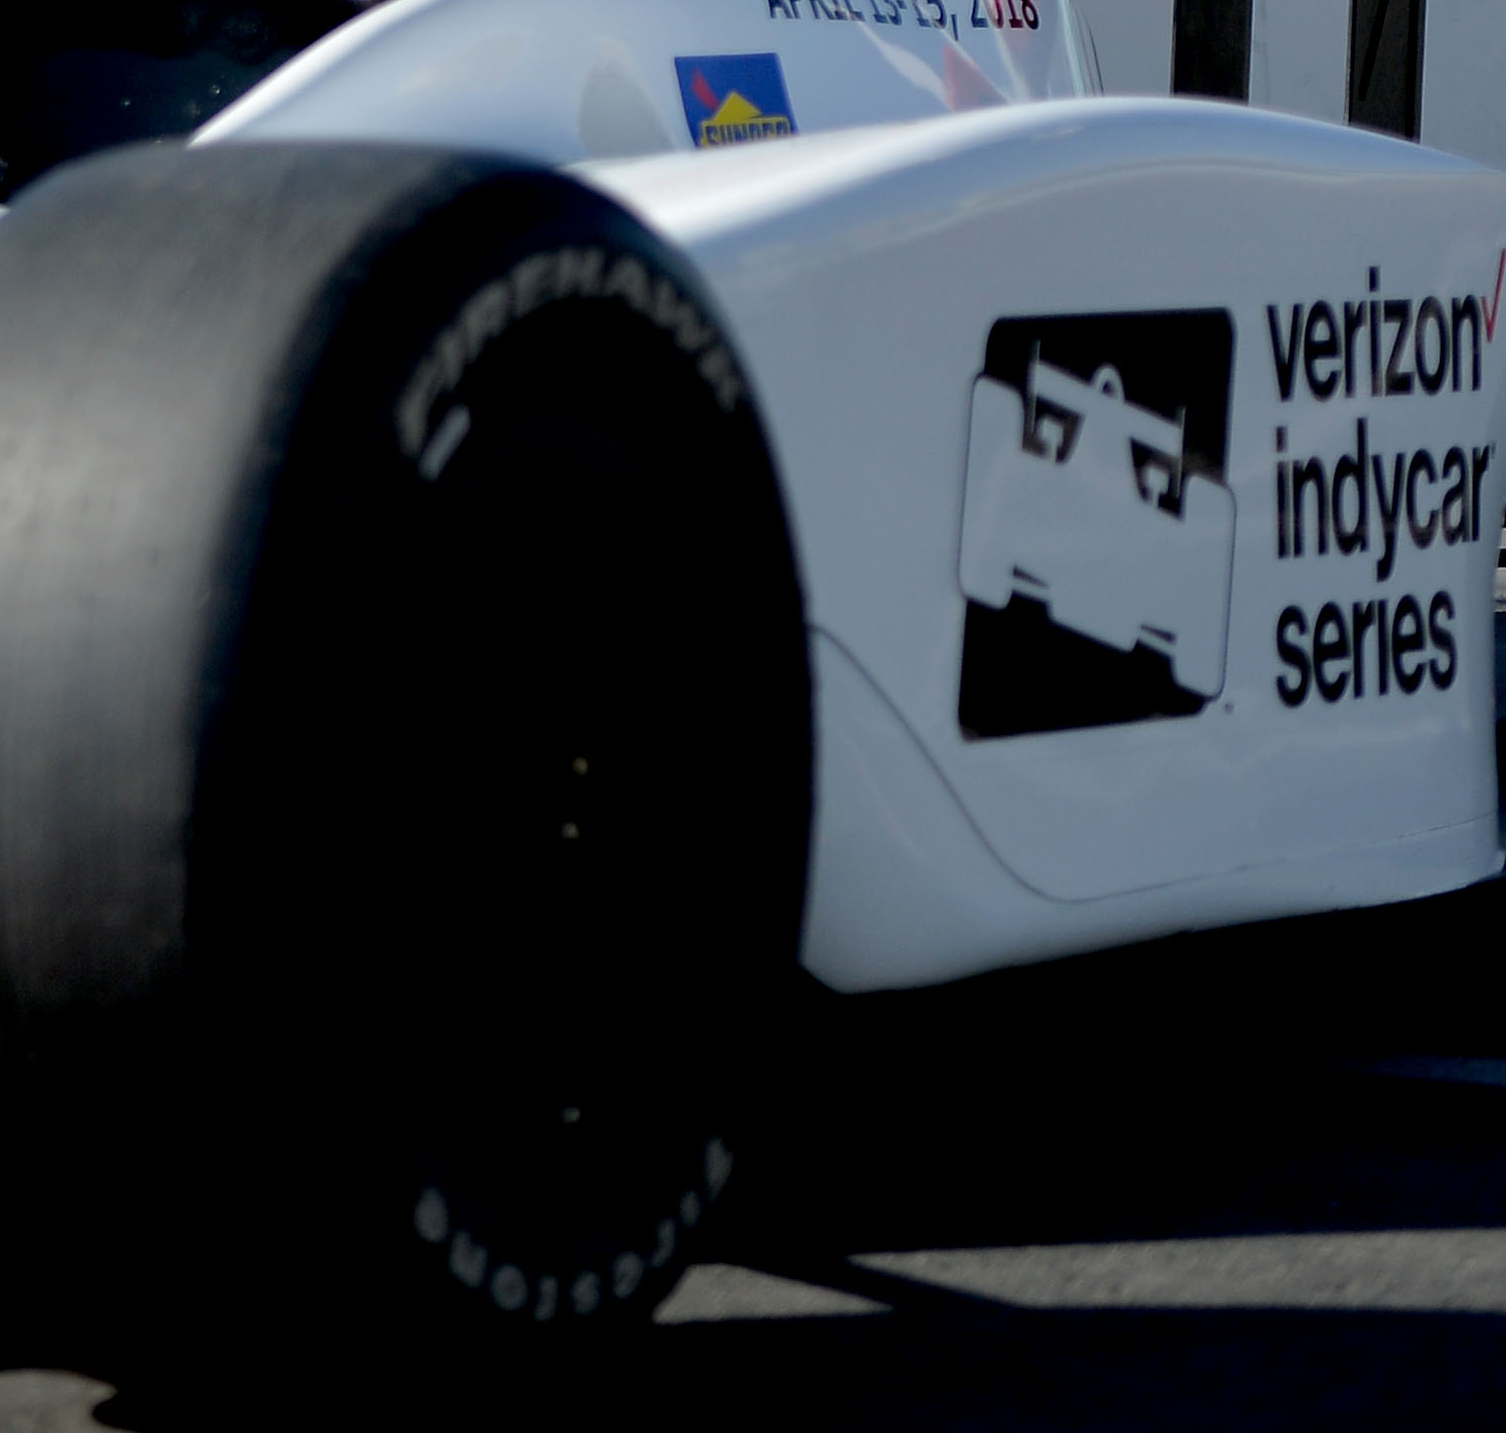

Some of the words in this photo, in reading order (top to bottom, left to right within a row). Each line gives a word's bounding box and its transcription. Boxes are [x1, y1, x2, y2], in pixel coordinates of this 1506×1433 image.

[1266, 266, 1482, 403] verizon
[1275, 417, 1491, 583] indycar
[1275, 590, 1459, 708] series
